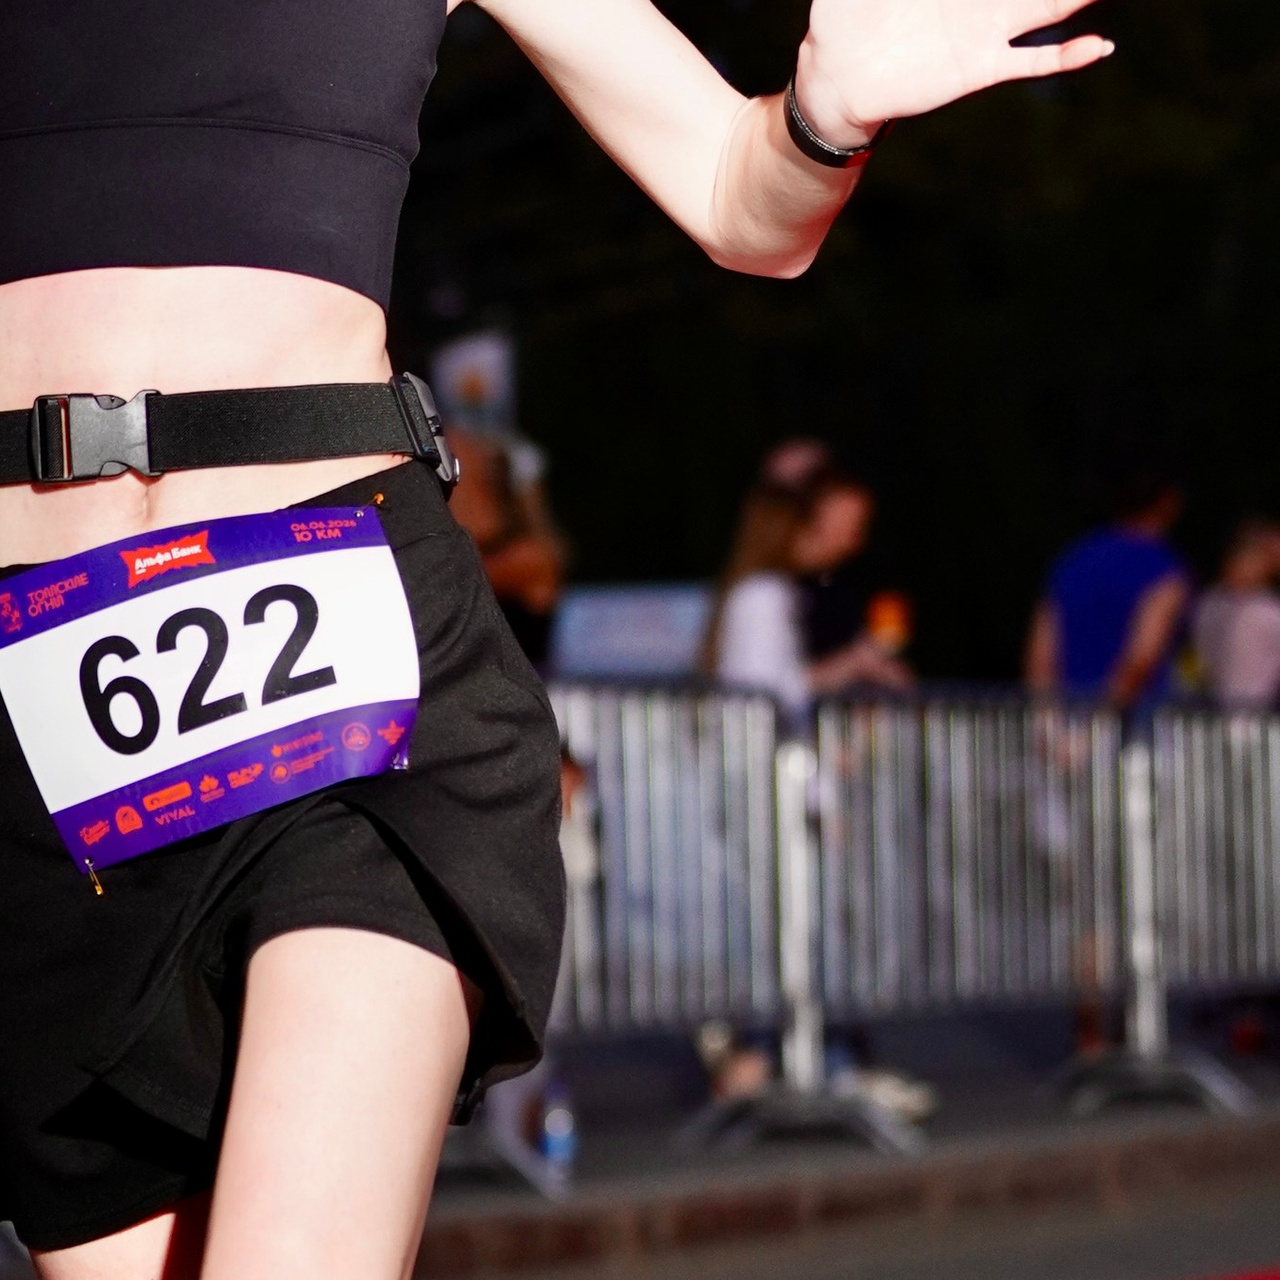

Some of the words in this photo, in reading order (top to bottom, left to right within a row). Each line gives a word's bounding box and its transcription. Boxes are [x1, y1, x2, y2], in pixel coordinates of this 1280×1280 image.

[294, 530, 313, 542] 10
[135, 551, 172, 570] Альфа
[171, 544, 202, 560] Банк
[27, 572, 89, 603] ТОМСКИЕ
[28, 594, 65, 617] ОГНИ
[80, 585, 336, 755] 622
